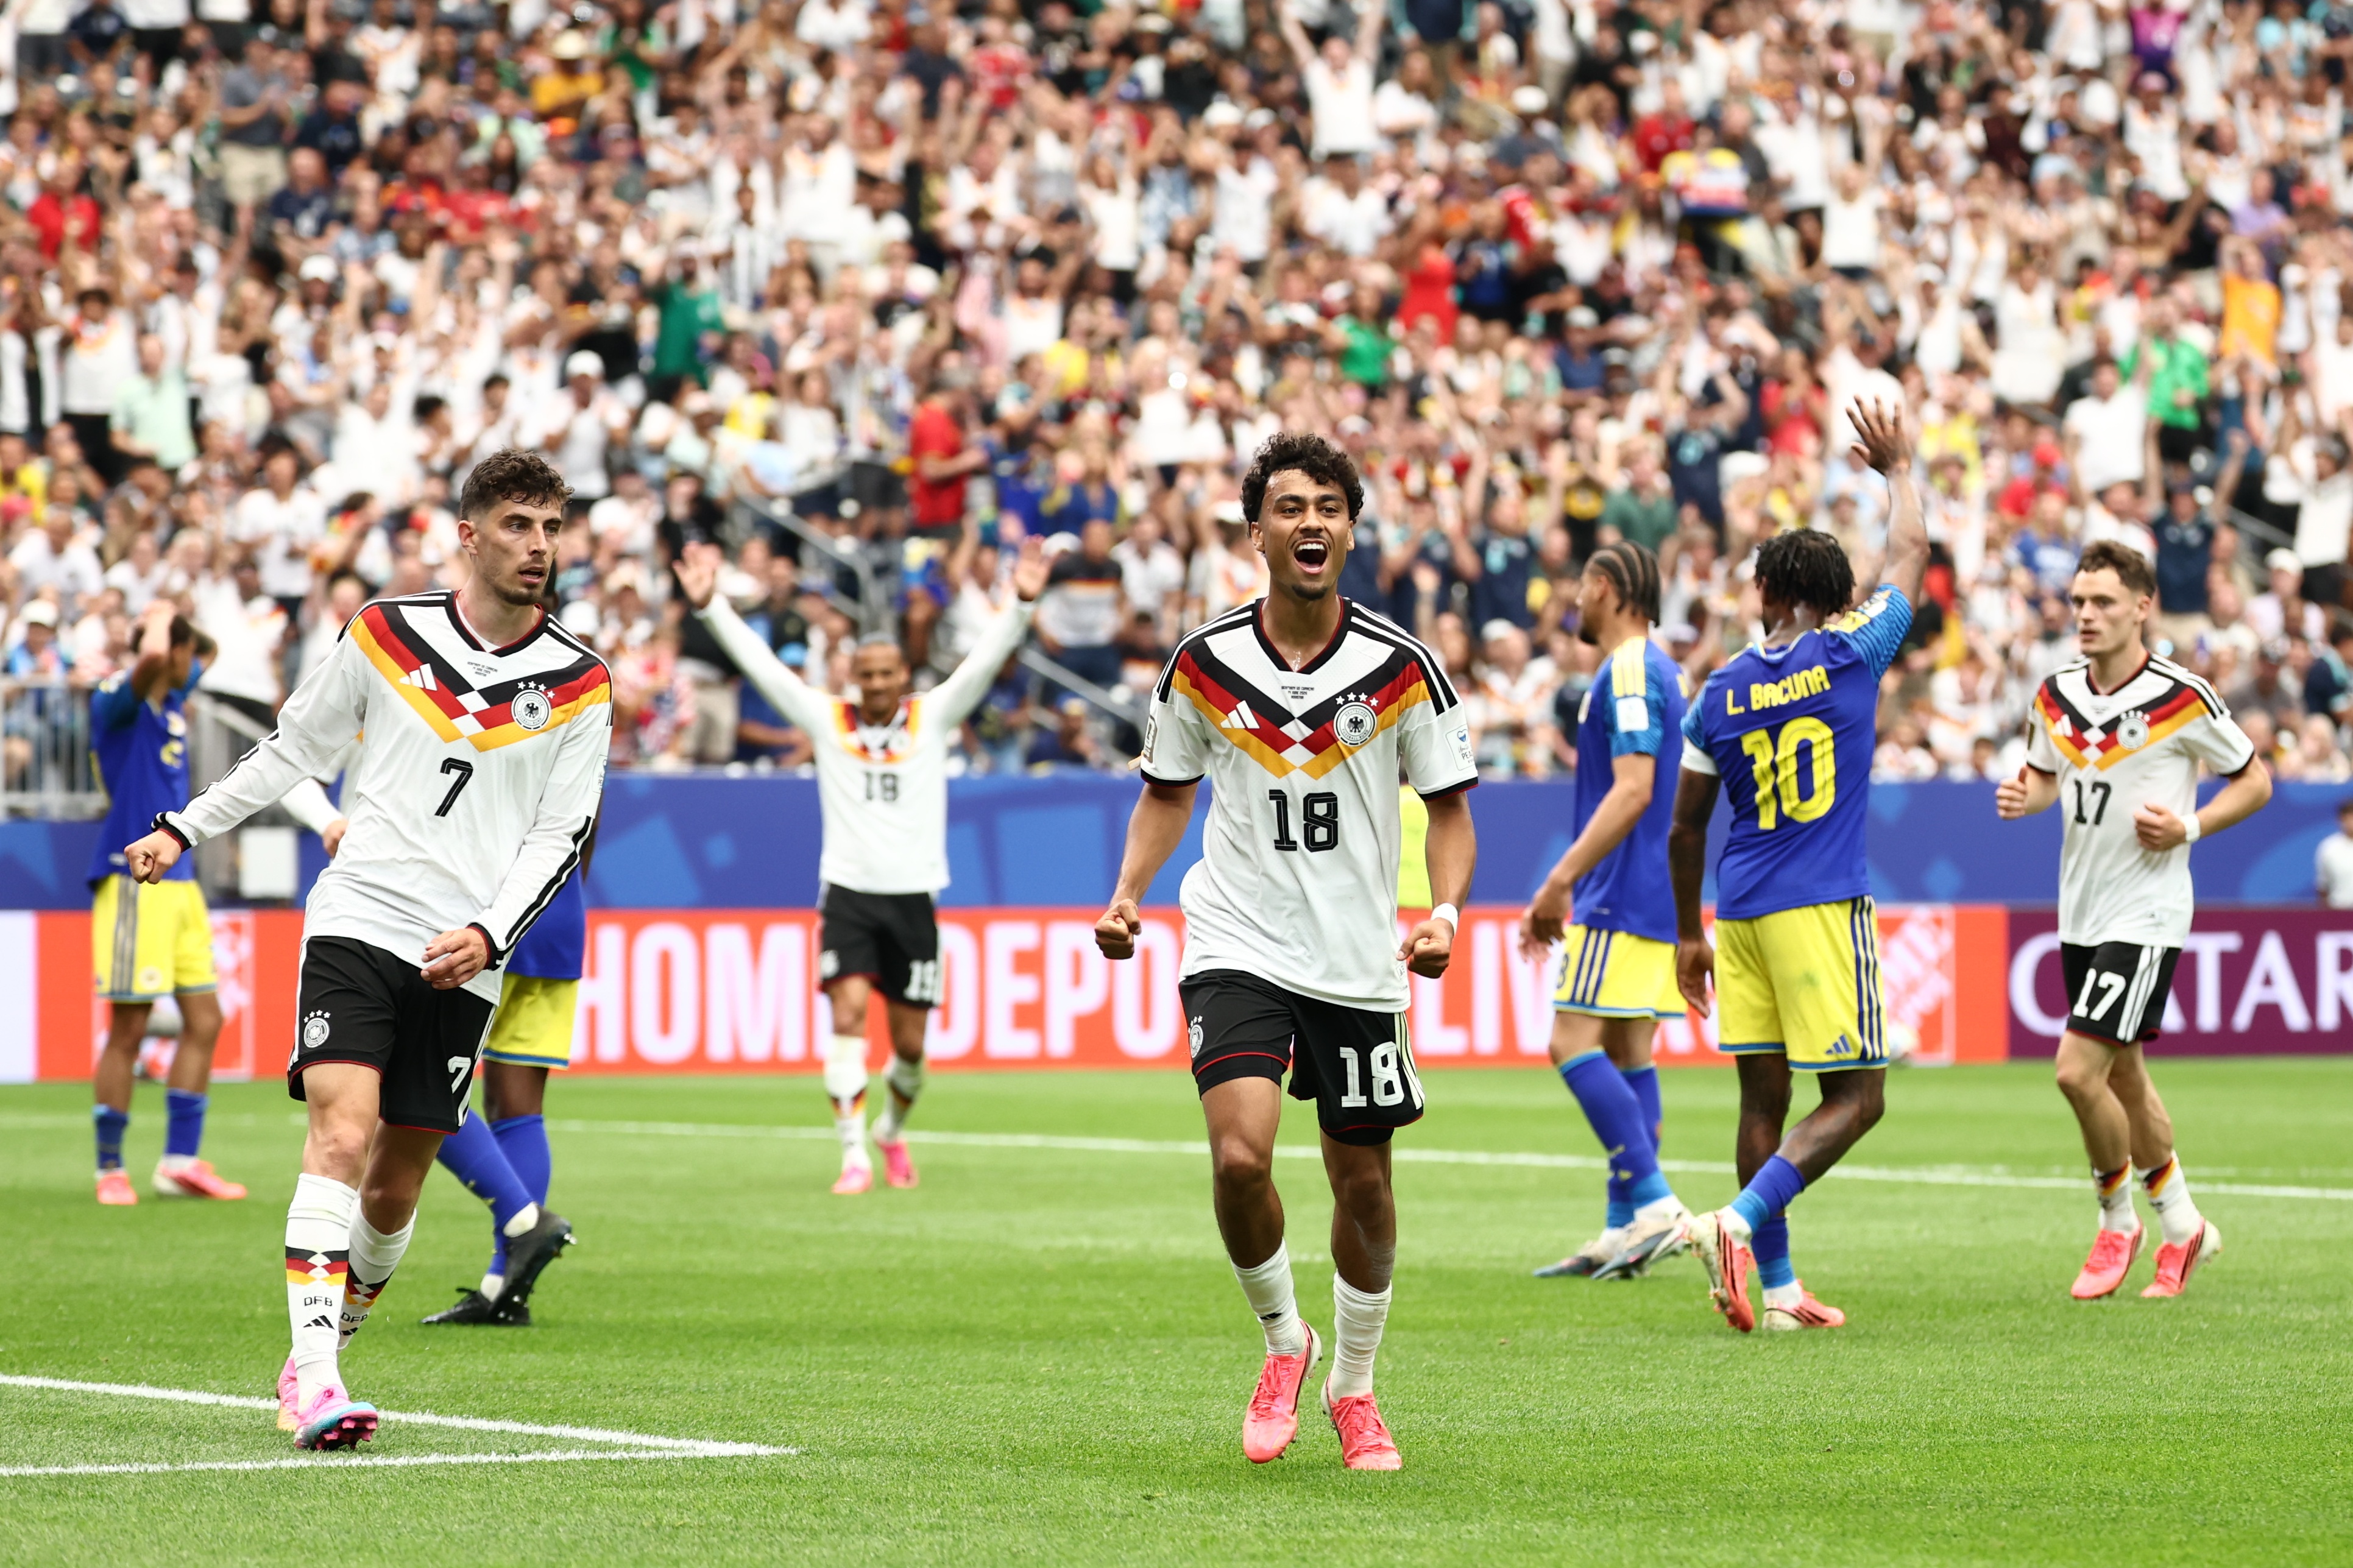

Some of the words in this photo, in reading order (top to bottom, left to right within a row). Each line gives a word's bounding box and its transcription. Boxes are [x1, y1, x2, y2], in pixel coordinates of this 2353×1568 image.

[1727, 688, 1746, 716] L.
[1750, 665, 1831, 711] BACUNA
[434, 757, 473, 817] 7
[1741, 716, 1836, 830] 10
[1268, 789, 1338, 852] 18
[2074, 779, 2112, 825] 17
[570, 922, 869, 1064] HOM
[922, 921, 1187, 1061] DEPO
[2073, 967, 2126, 1022] 17
[447, 1056, 472, 1094] 7
[1340, 1041, 1404, 1107] 18
[304, 1296, 333, 1307] DFB
